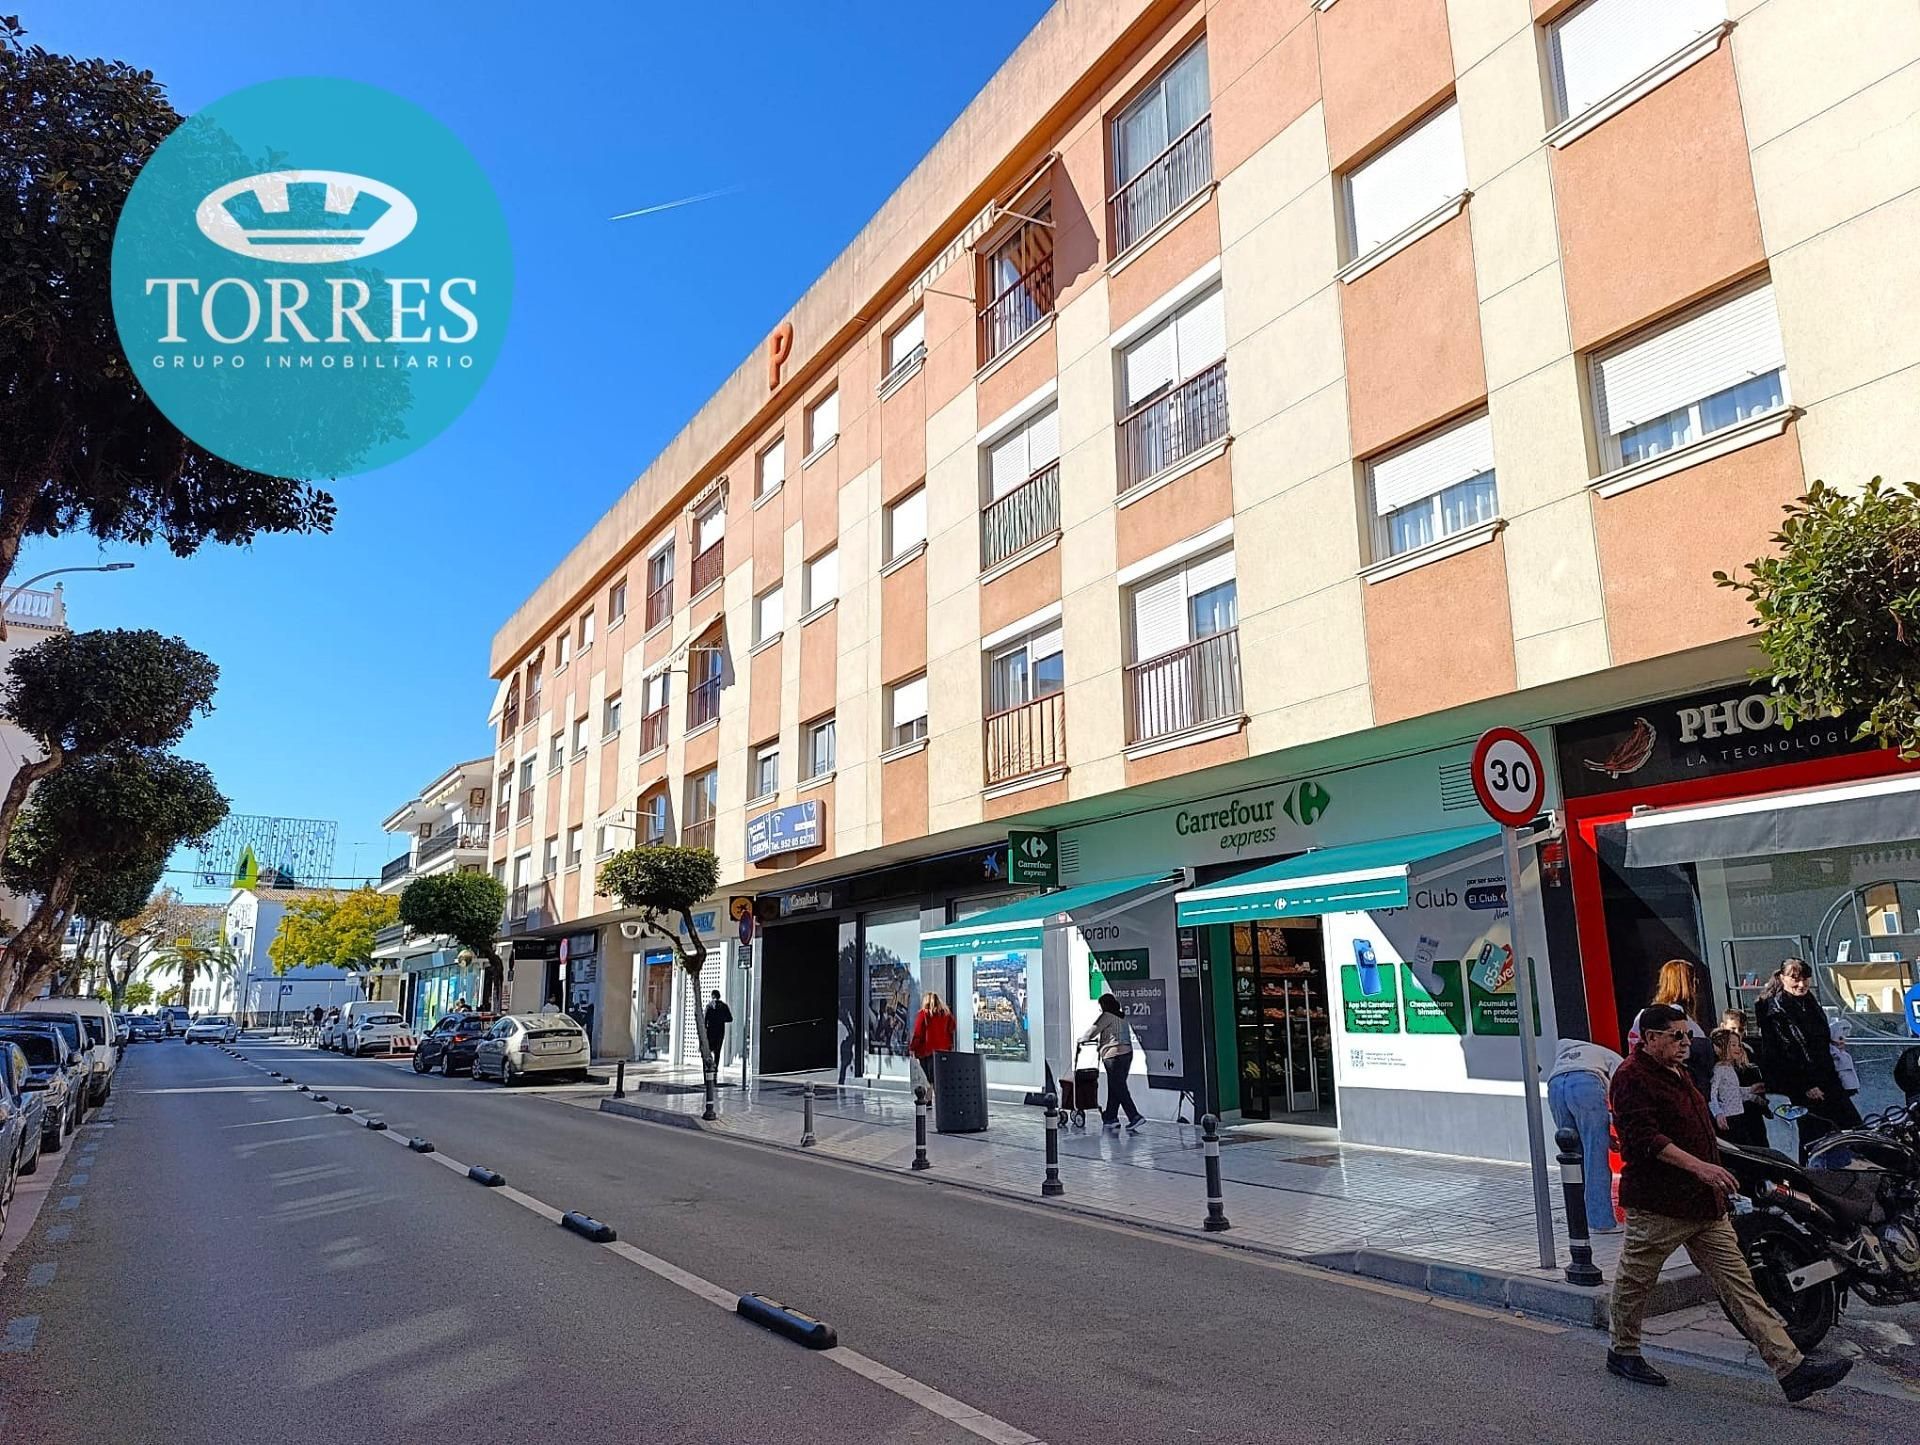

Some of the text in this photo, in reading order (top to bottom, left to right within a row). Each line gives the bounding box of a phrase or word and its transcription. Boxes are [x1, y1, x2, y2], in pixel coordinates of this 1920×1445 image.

[1687, 727, 1850, 767] LA TECNOLOGÍ
[1490, 759, 1530, 793] 30
[1175, 799, 1275, 836] Carrefour
[1220, 825, 1276, 855] express
[1017, 860, 1052, 870] Carrefour
[1415, 888, 1458, 909] Club
[1469, 892, 1498, 903] El Club
[1077, 922, 1120, 940] Horario
[1092, 957, 1138, 972] Abrimos
[1125, 1002, 1151, 1016] a 22h
[1493, 1008, 1519, 1018] produc
